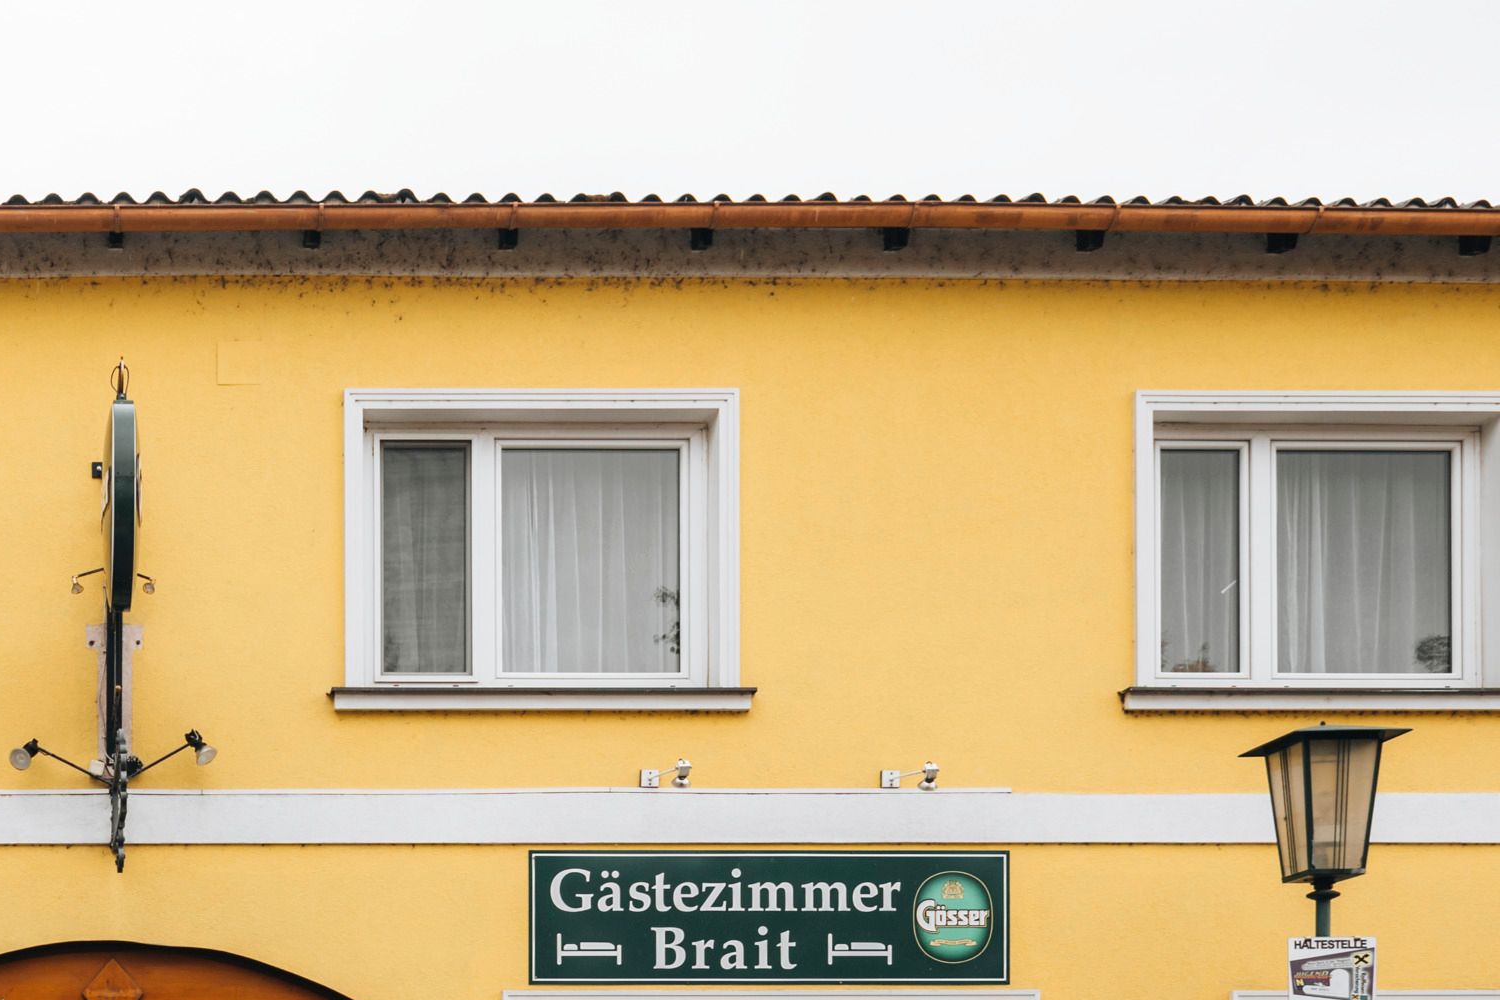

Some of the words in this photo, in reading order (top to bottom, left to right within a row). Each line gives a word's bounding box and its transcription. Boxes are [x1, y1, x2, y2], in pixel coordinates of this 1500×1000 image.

[550, 868, 901, 913] Gästezimmer
[916, 899, 990, 934] Gösser
[650, 926, 797, 971] Brait
[1294, 940, 1367, 949] HALTESTELLE
